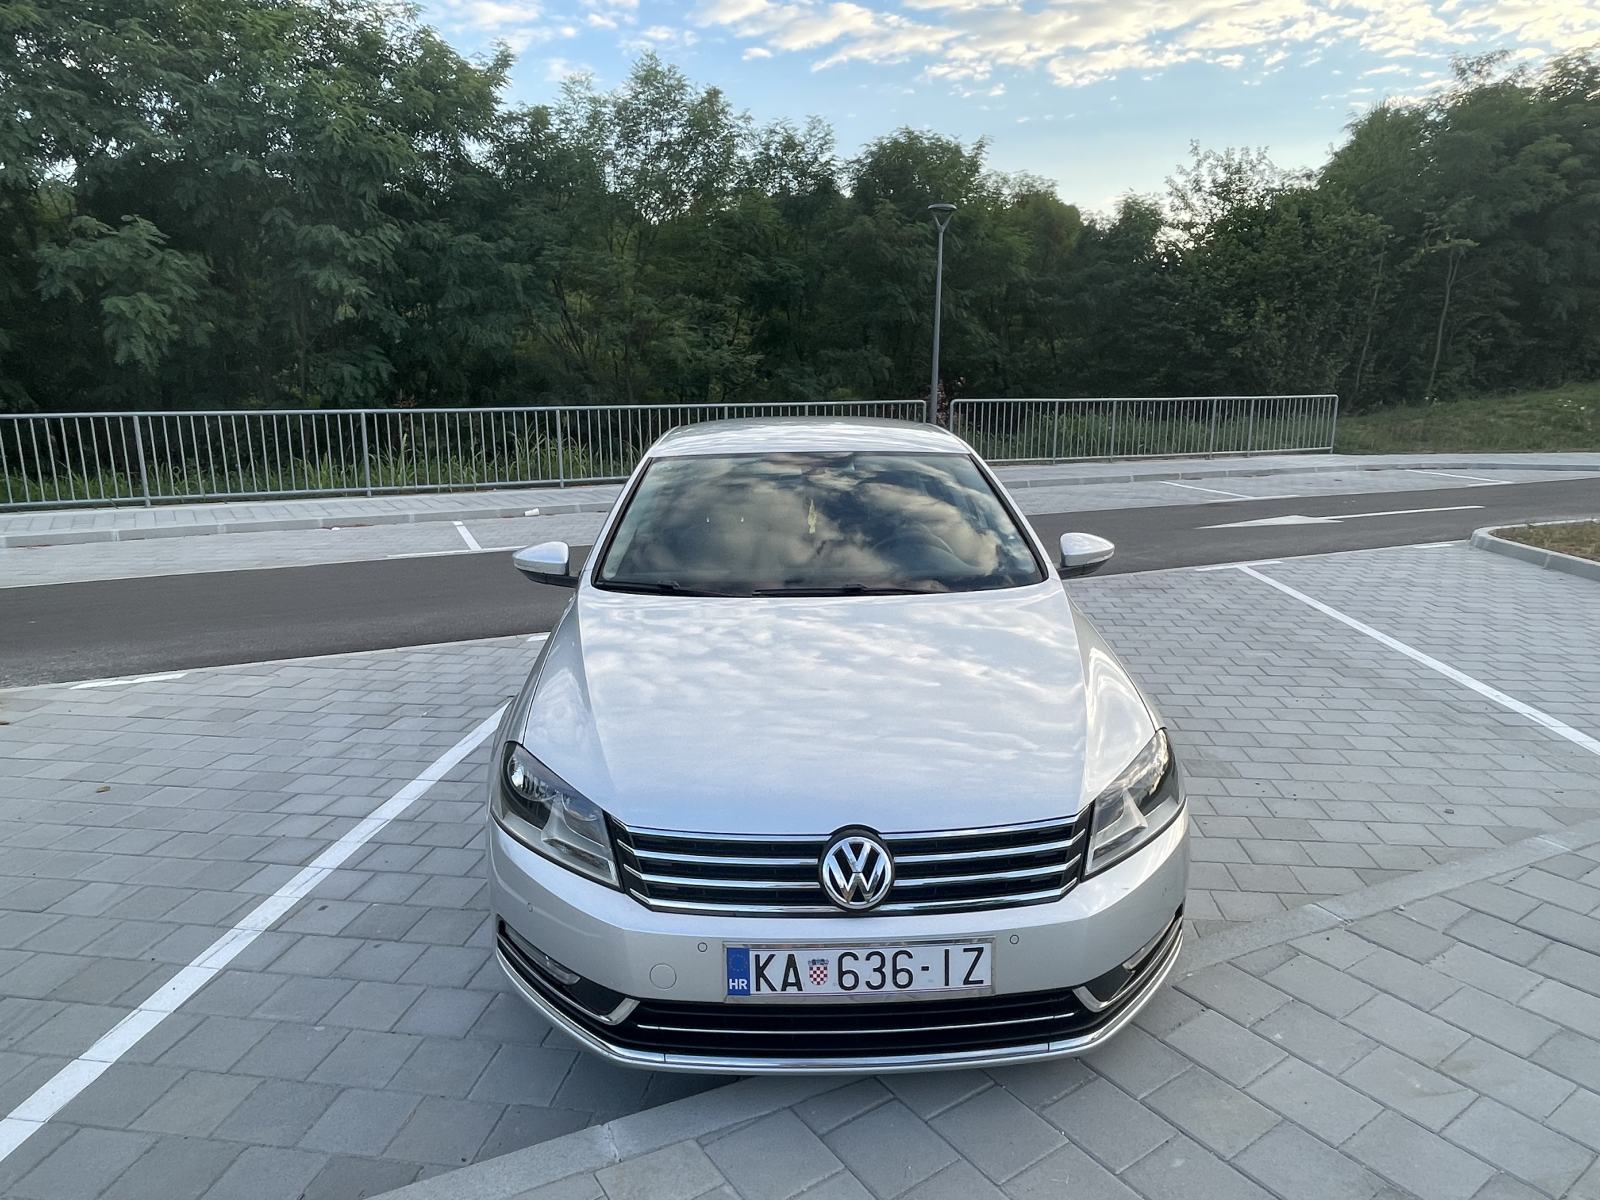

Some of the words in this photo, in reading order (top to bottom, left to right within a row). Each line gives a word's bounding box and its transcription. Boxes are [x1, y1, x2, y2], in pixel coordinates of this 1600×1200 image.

[824, 838, 890, 905] VW
[729, 978, 748, 990] HR
[754, 953, 803, 992] KA
